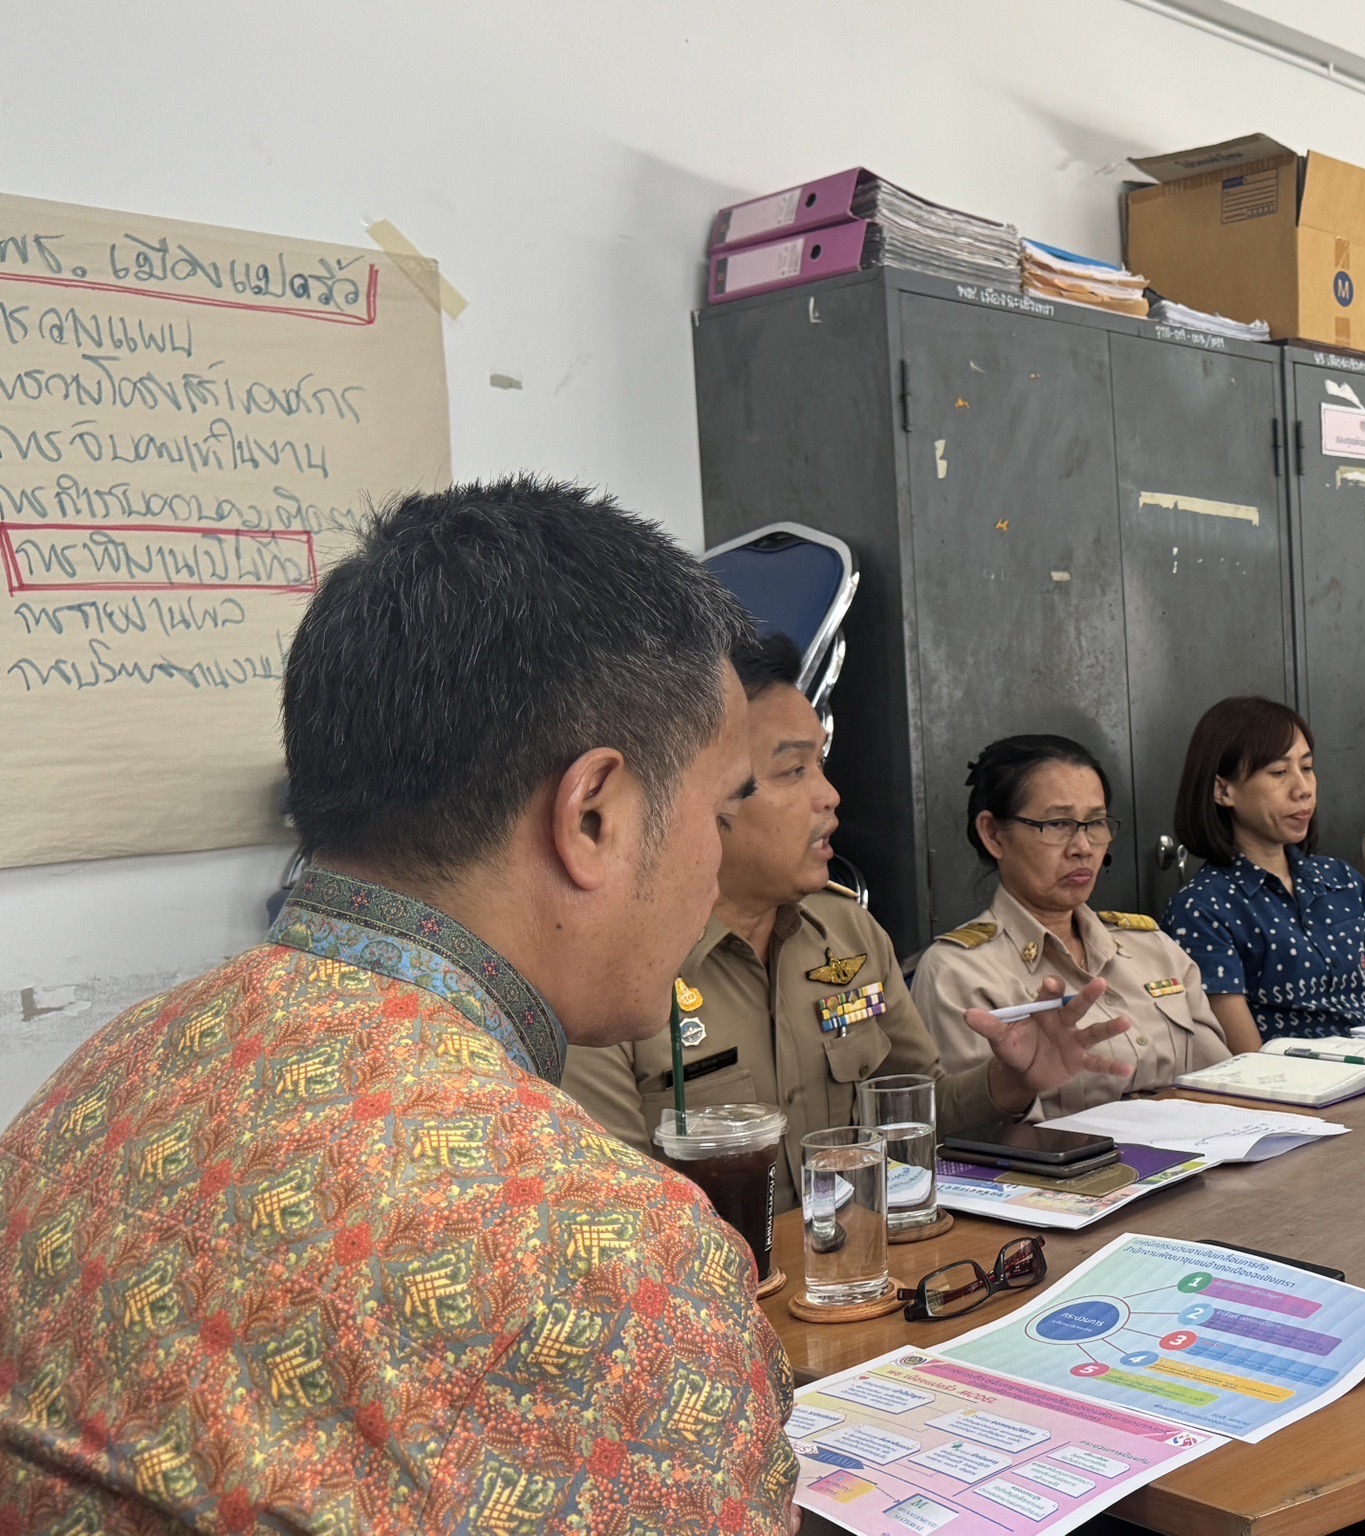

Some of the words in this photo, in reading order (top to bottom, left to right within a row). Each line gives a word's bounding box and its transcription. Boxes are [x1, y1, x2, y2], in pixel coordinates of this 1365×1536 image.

[1188, 1276, 1203, 1288] 1
[1186, 1307, 1205, 1320] 2
[1061, 1312, 1105, 1327] กระบวนการ
[1168, 1335, 1188, 1345] 3
[1129, 1354, 1148, 1363] 4
[1079, 1365, 1100, 1374] 5
